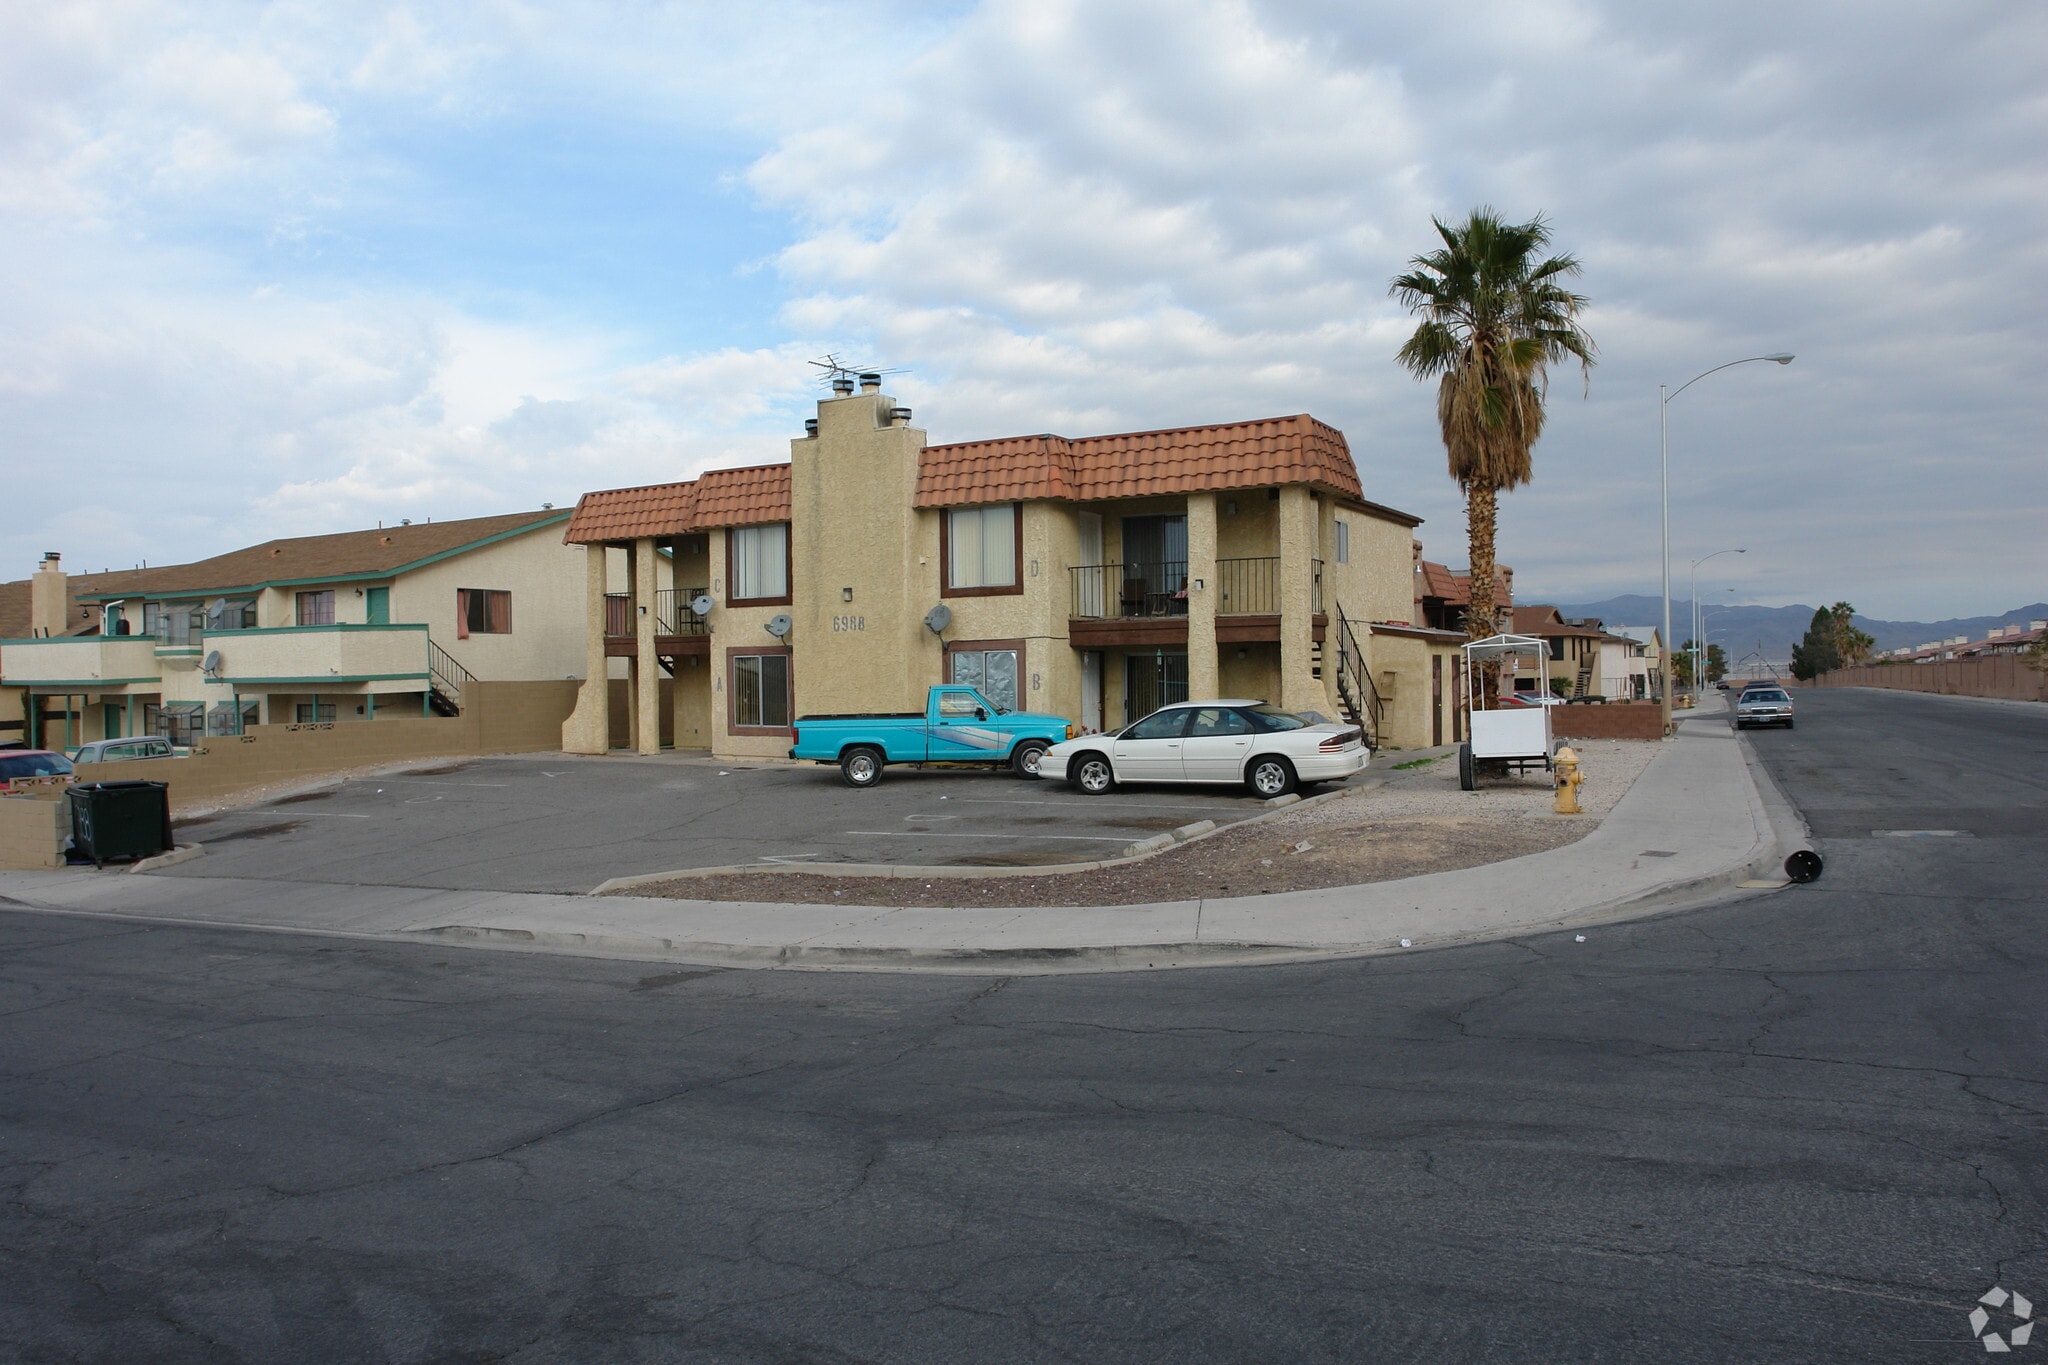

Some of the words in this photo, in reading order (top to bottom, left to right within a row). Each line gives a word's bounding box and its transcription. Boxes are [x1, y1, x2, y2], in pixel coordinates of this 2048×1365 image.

[714, 578, 721, 593] C
[833, 615, 865, 632] 6988
[716, 676, 723, 692] A
[1032, 673, 1041, 691] B
